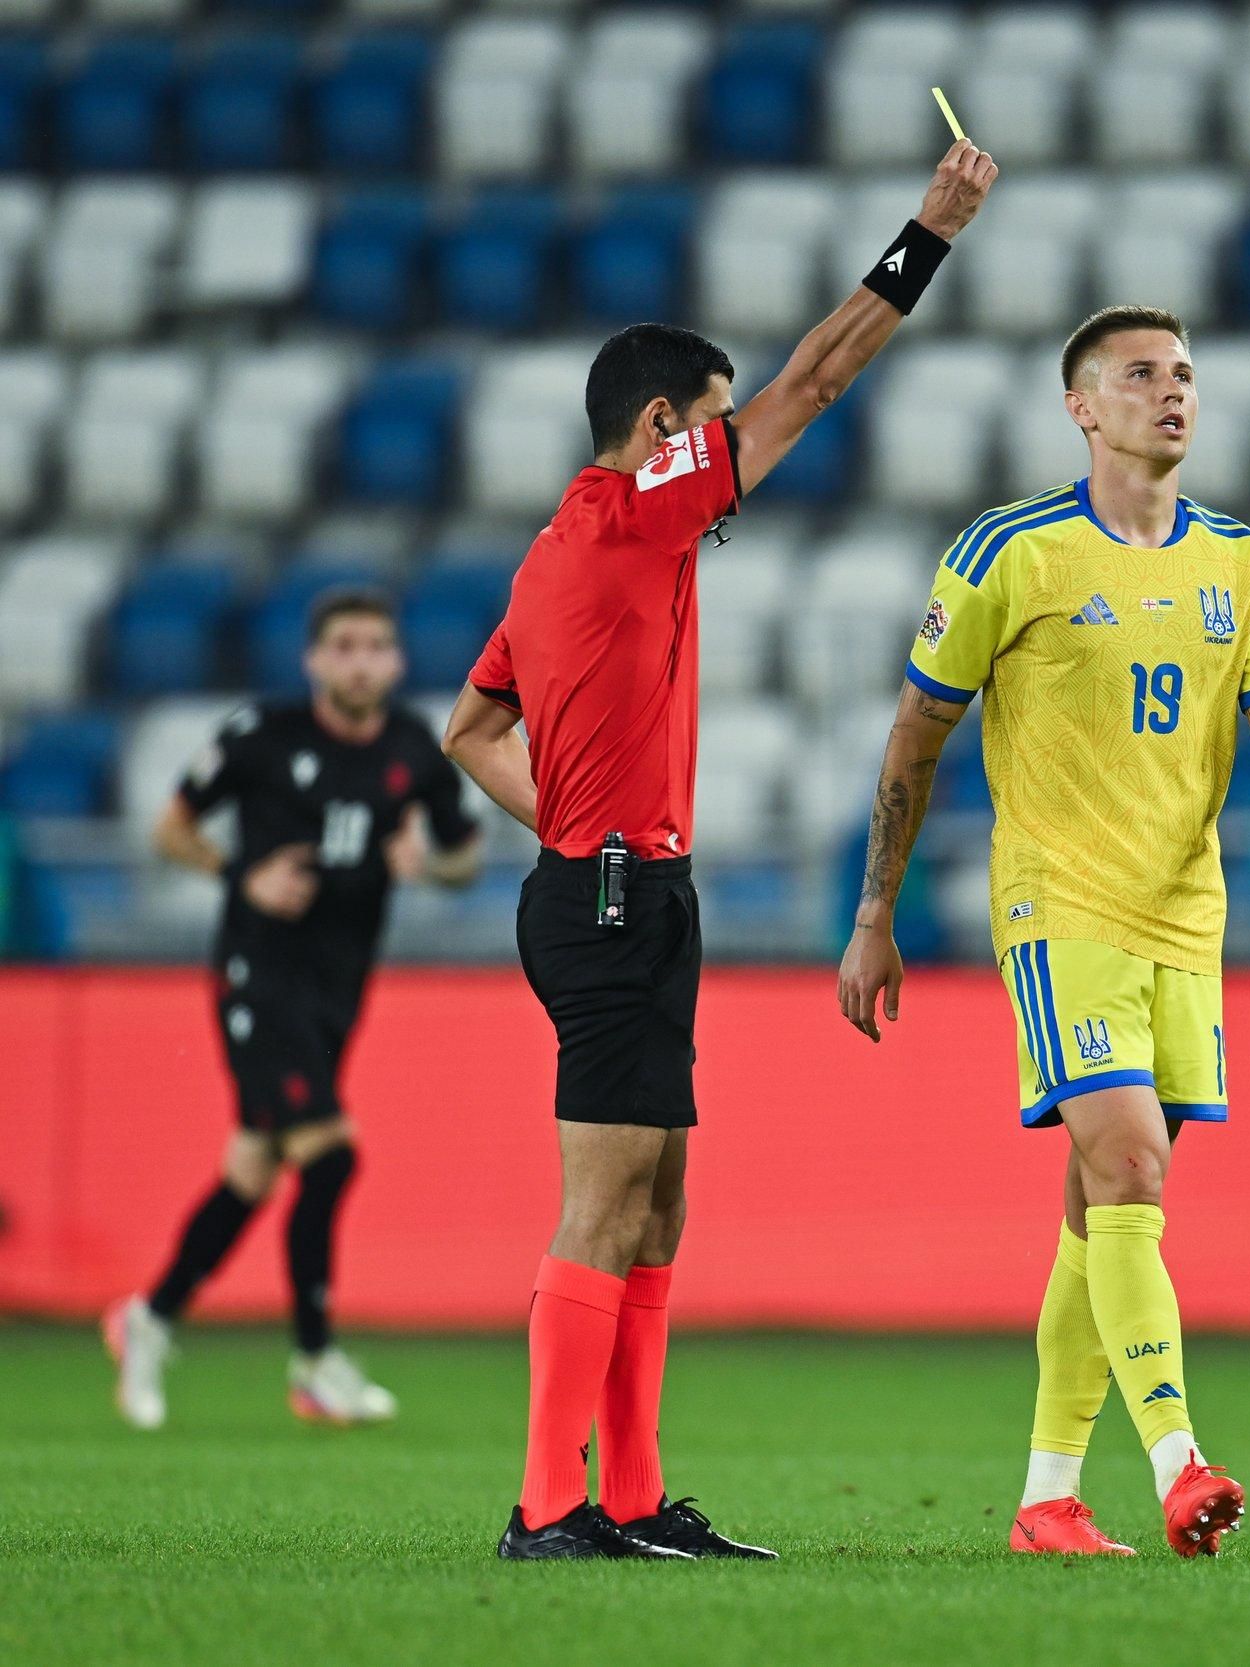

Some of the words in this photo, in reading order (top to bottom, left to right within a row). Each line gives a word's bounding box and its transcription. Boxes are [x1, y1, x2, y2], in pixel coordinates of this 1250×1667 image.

[1130, 662, 1183, 735] 19
[1083, 1057, 1114, 1069] UKRAINE
[1125, 1341, 1170, 1360] UAF
